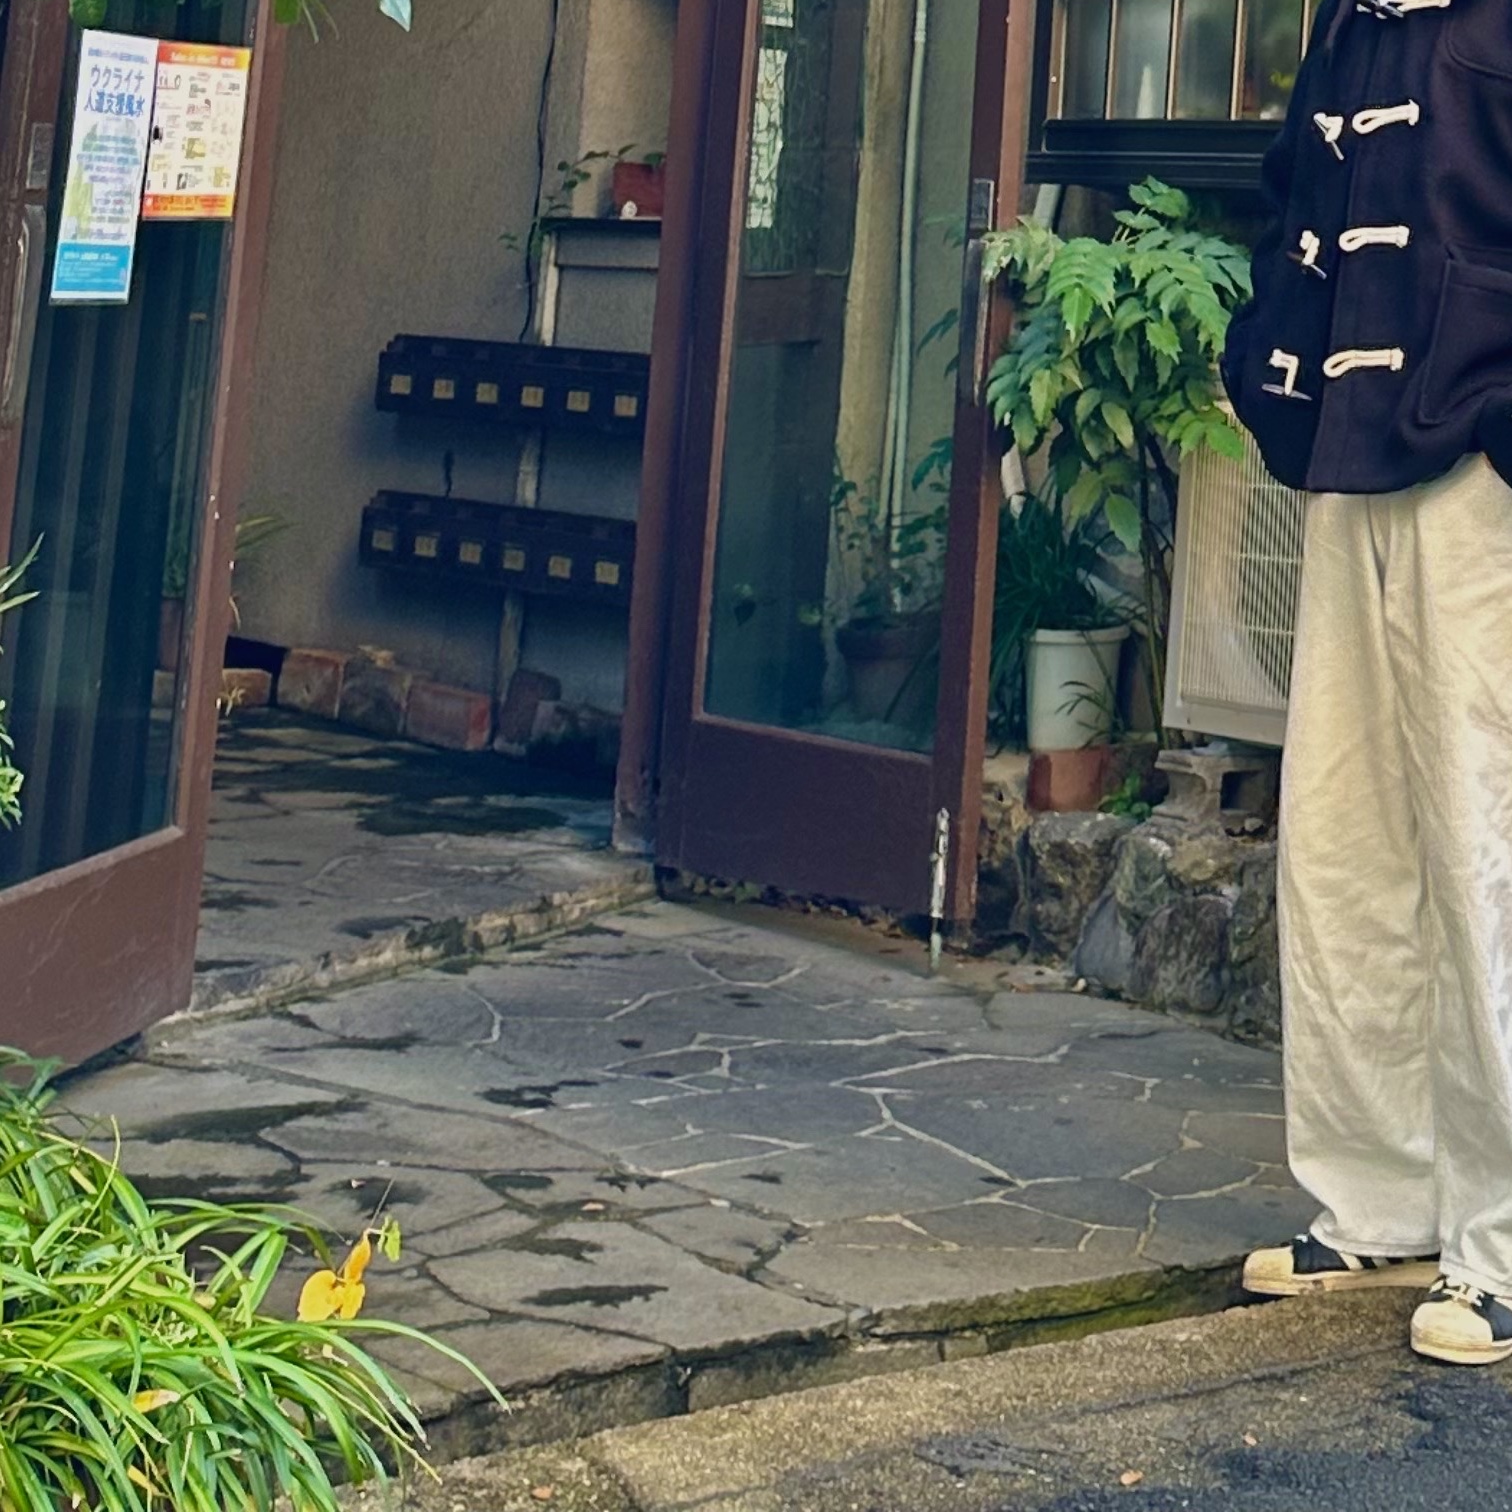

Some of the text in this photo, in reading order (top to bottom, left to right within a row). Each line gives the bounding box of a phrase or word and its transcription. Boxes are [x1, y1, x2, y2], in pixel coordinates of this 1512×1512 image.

[90, 64, 145, 93] ウクライナ
